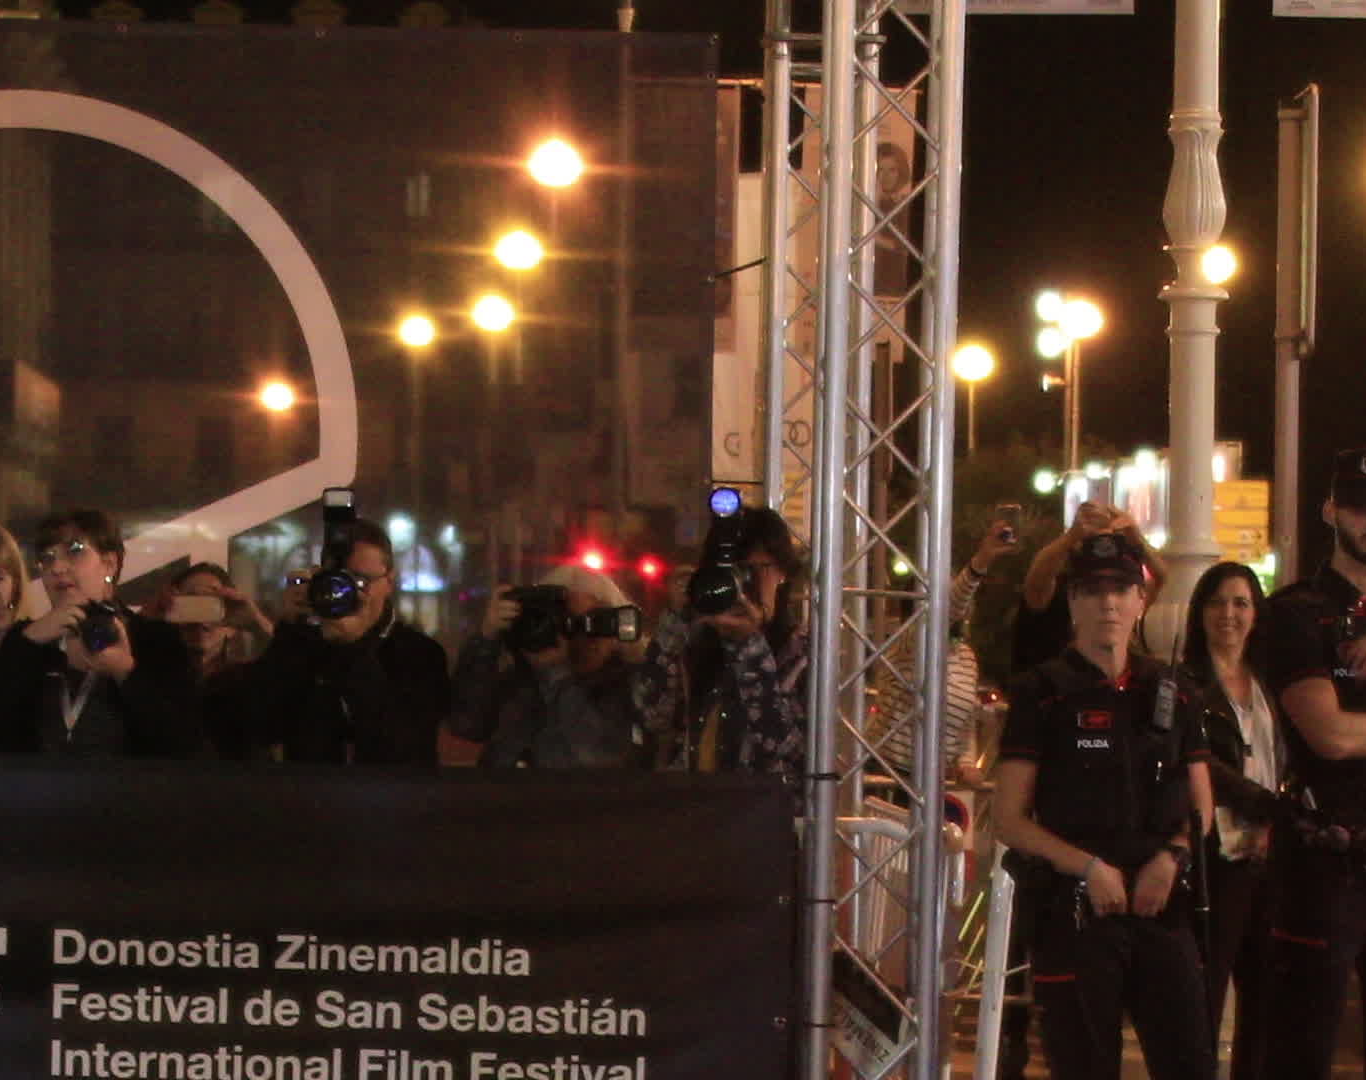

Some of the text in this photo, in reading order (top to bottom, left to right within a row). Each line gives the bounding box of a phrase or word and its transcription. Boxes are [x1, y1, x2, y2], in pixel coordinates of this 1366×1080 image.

[1076, 739, 1110, 749] POLIZIA
[52, 927, 530, 976] Donostia Zinemaldia
[51, 982, 646, 1037] Festival de San Sebastián
